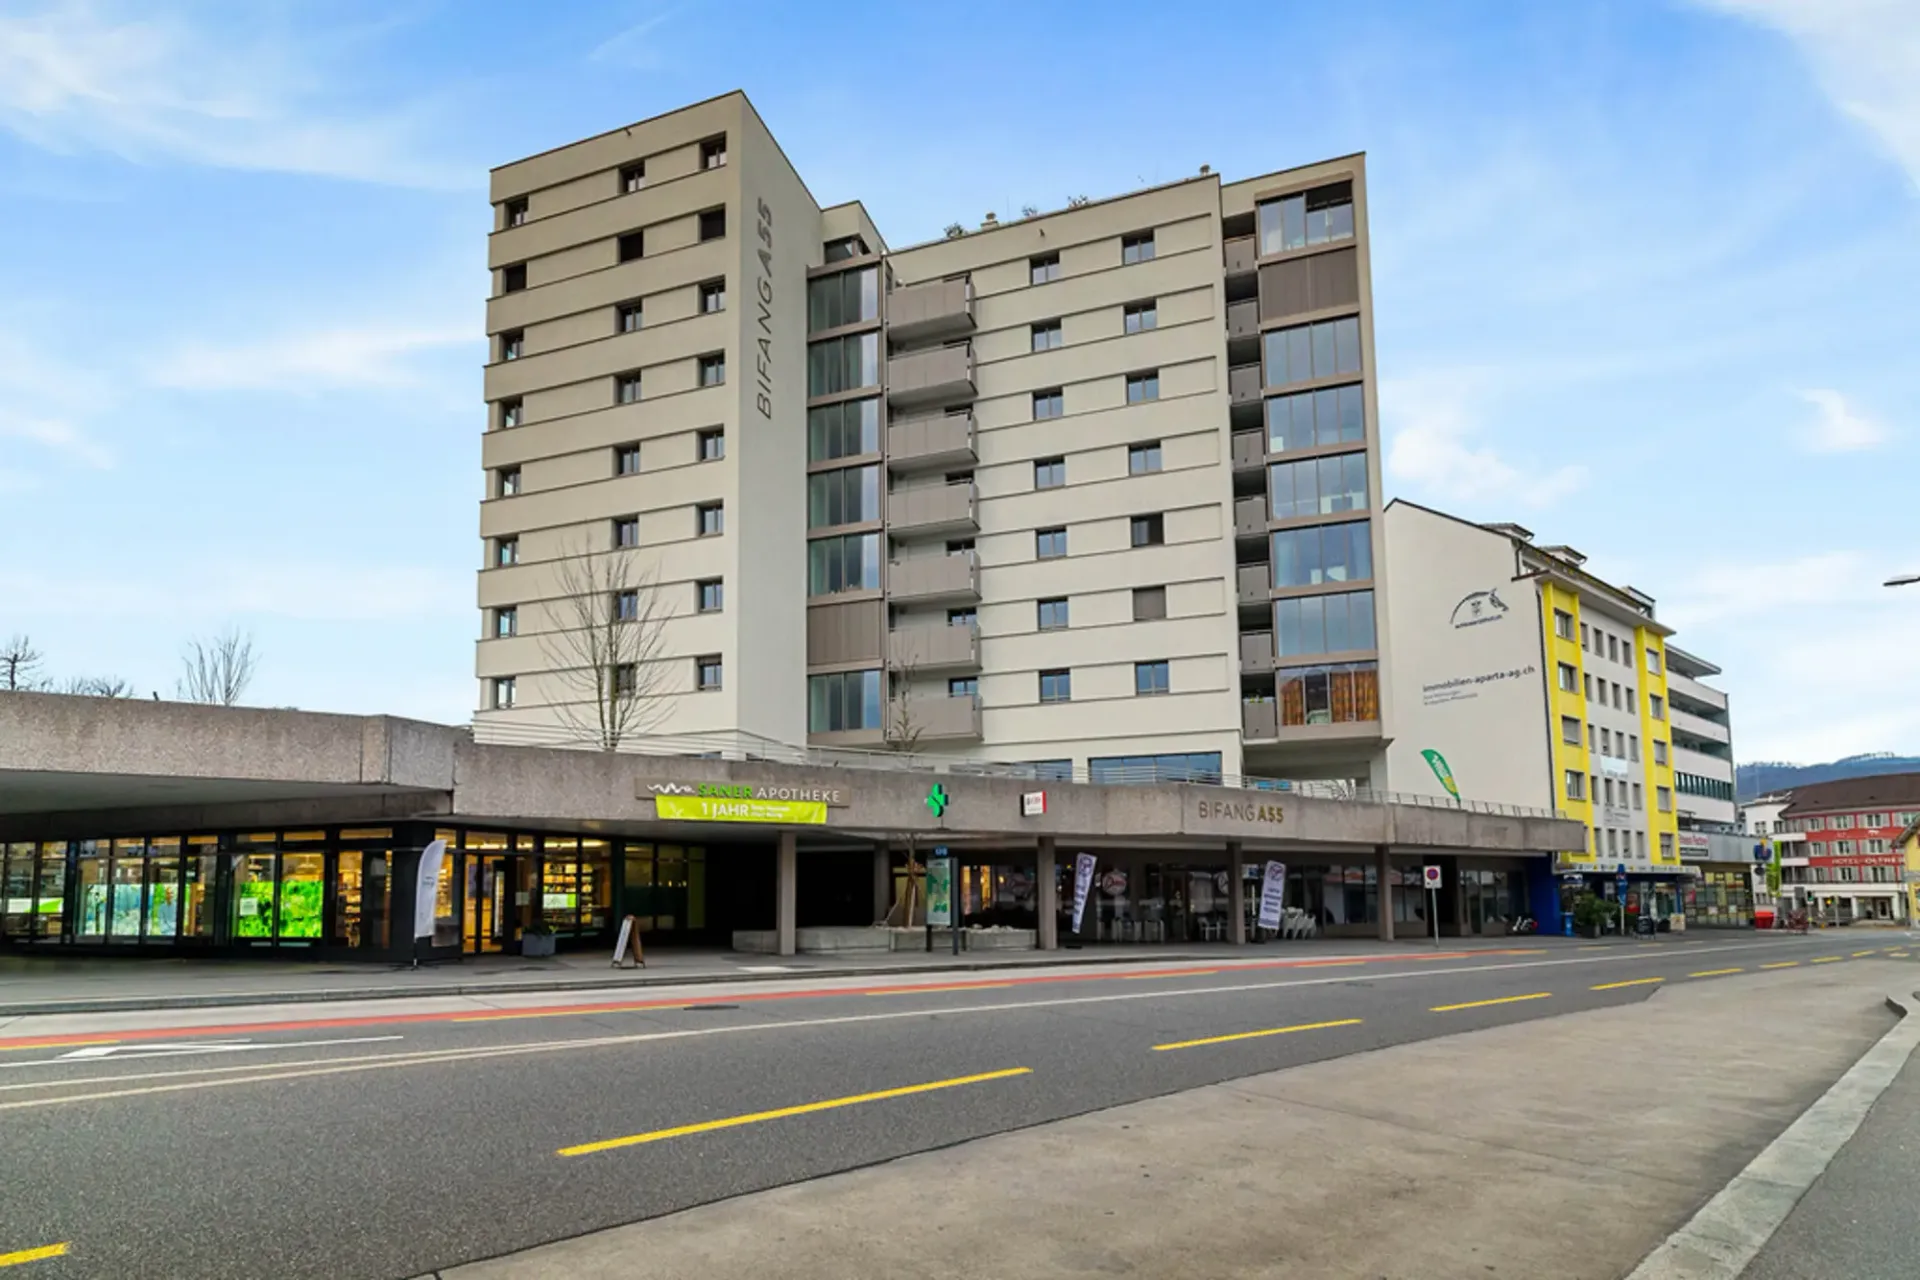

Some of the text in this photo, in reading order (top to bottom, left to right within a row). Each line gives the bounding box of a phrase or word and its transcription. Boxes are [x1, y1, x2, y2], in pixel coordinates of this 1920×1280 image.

[698, 782, 841, 803] SANER APOTHEKE
[701, 802, 708, 816] 1
[712, 802, 749, 819] JAHR
